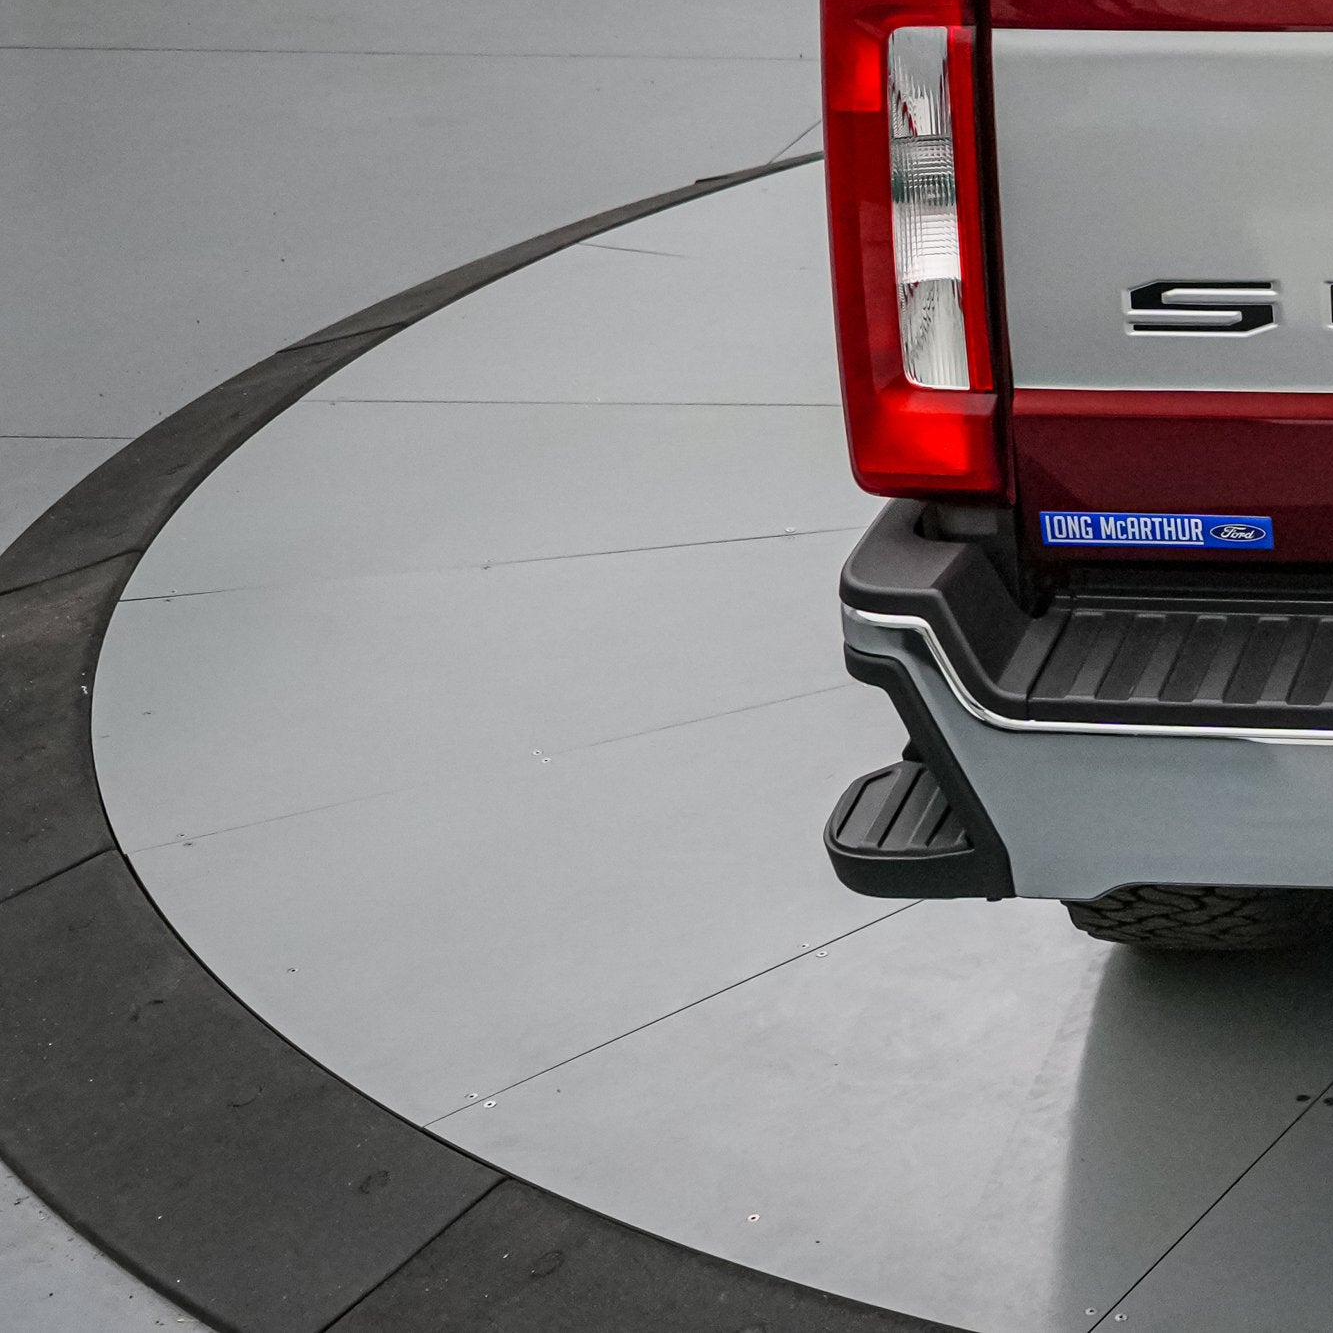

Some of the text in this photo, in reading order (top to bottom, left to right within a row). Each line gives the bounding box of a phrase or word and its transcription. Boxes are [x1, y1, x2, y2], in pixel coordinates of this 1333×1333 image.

[1045, 515, 1255, 542] LONG McARTHUR Ford
